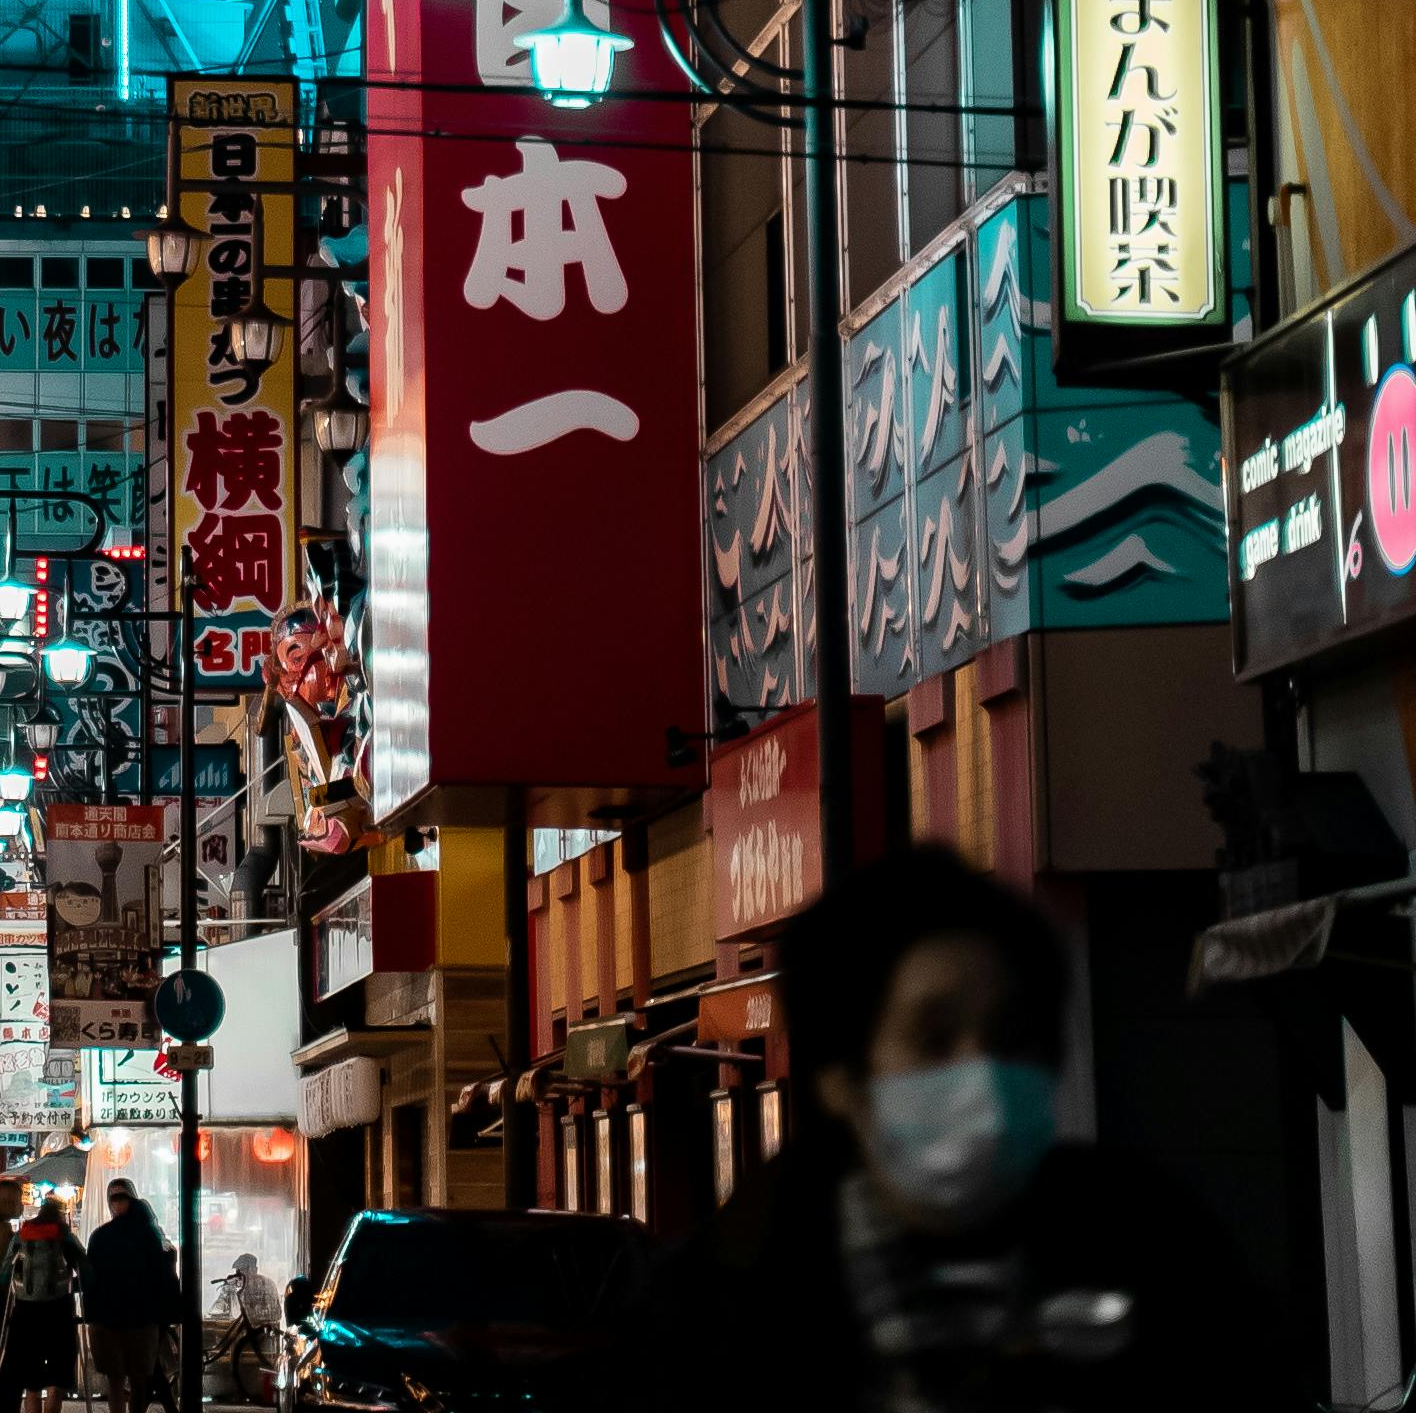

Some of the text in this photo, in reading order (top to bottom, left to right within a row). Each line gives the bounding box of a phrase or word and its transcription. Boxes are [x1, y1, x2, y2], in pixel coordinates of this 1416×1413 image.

[1242, 403, 1346, 494] comic magazine
[184, 411, 287, 615] 横綱
[1241, 491, 1322, 582] game drink
[85, 806, 127, 822] 通天閣
[158, 761, 229, 789] Aahi
